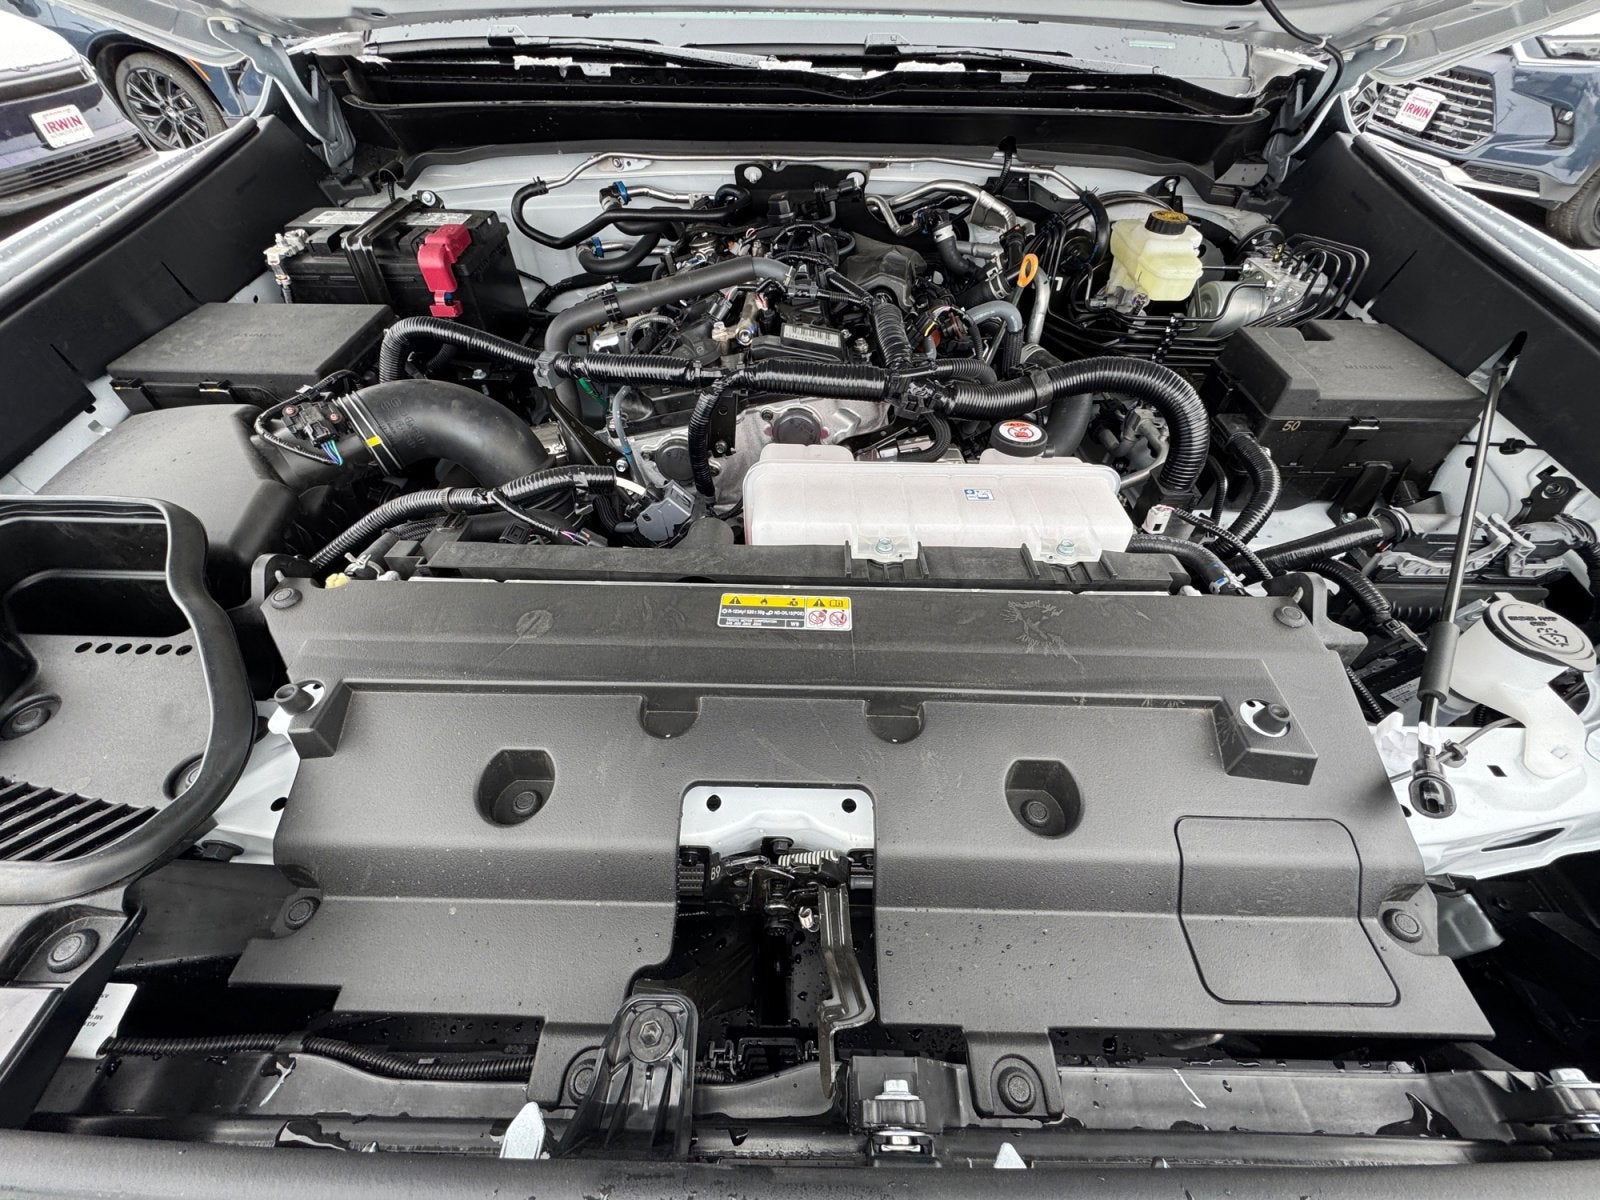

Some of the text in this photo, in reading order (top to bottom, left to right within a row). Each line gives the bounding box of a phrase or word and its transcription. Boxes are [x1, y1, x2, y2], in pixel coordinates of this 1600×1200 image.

[1403, 102, 1432, 119] IRWIN
[42, 115, 83, 134] IRWIN
[1281, 420, 1301, 432] 50
[710, 865, 721, 881] B9
